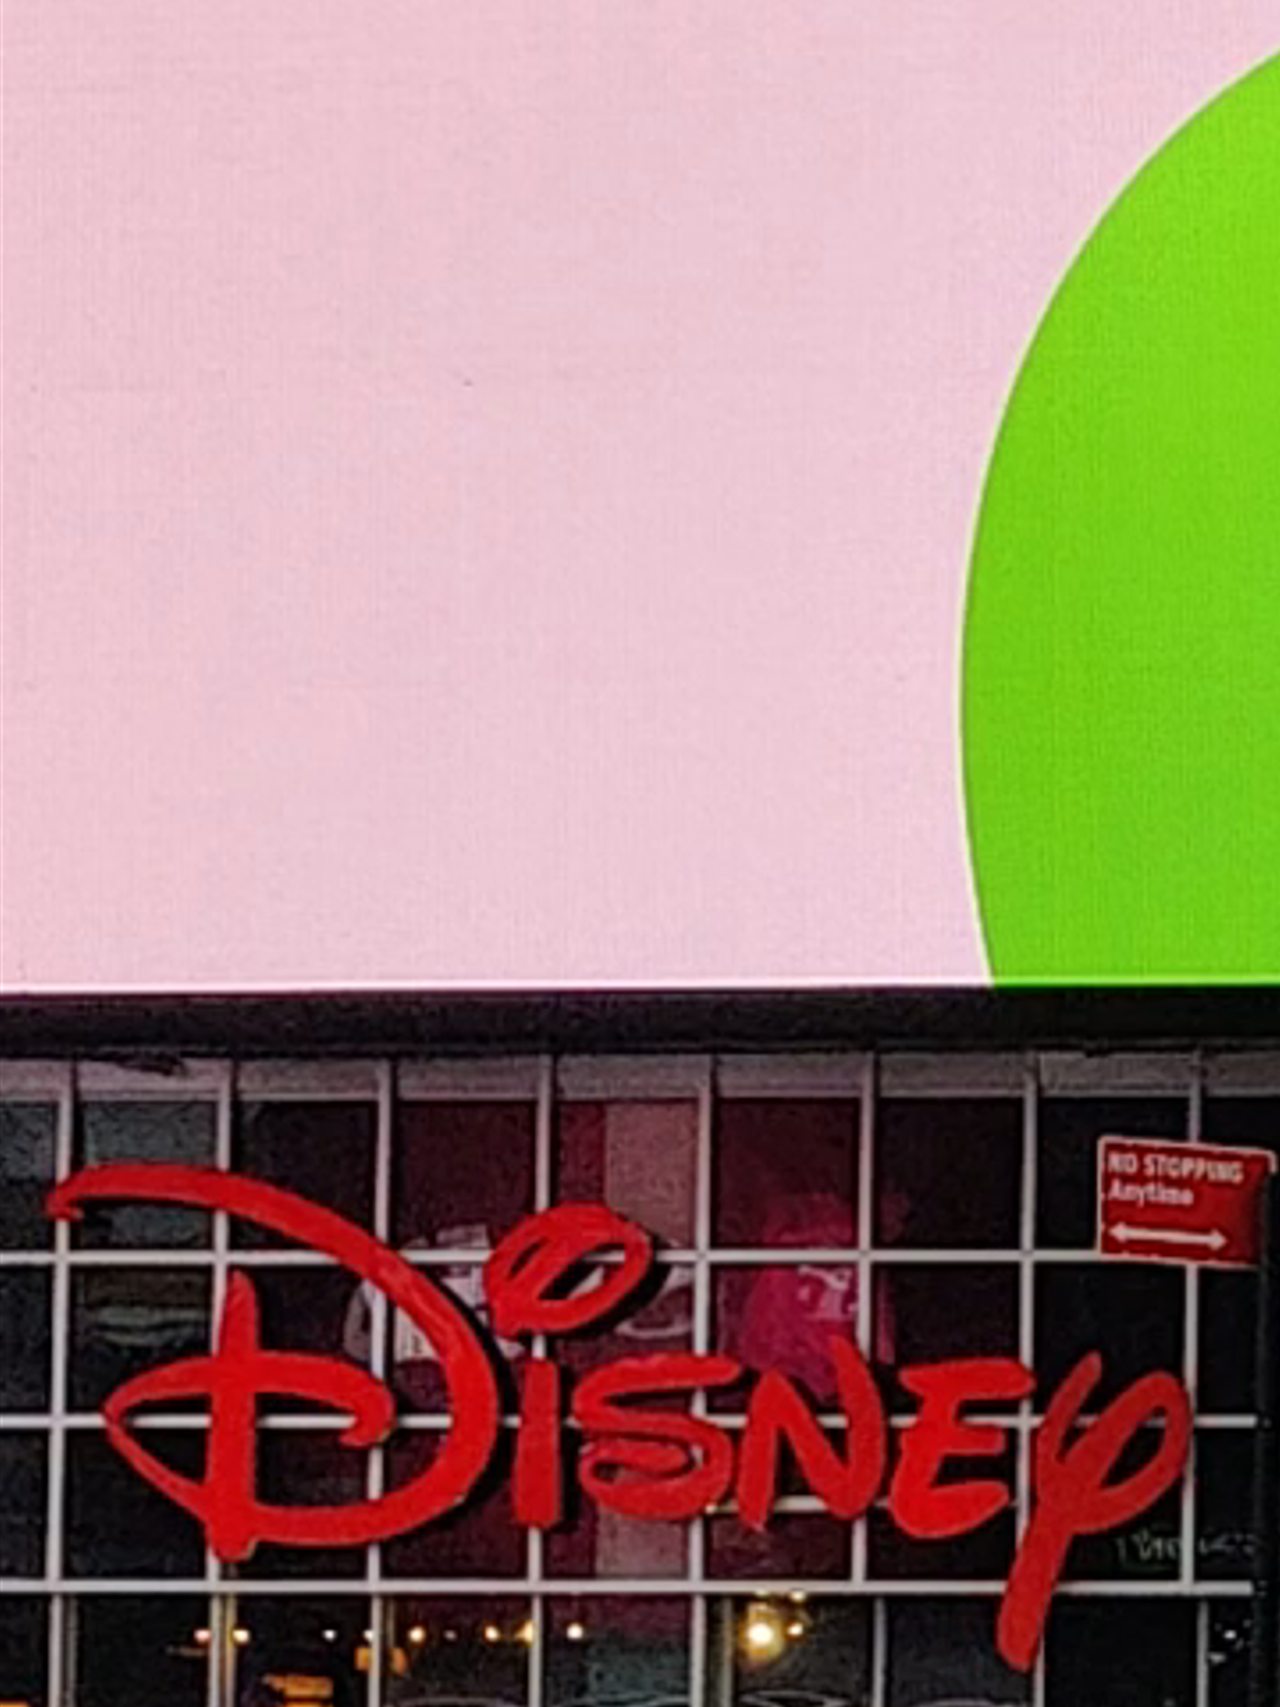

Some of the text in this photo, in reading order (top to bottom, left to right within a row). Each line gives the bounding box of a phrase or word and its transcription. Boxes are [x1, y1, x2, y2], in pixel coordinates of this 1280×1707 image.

[1107, 1152, 1243, 1183] NO STOPPING
[1108, 1178, 1193, 1207] Anytime
